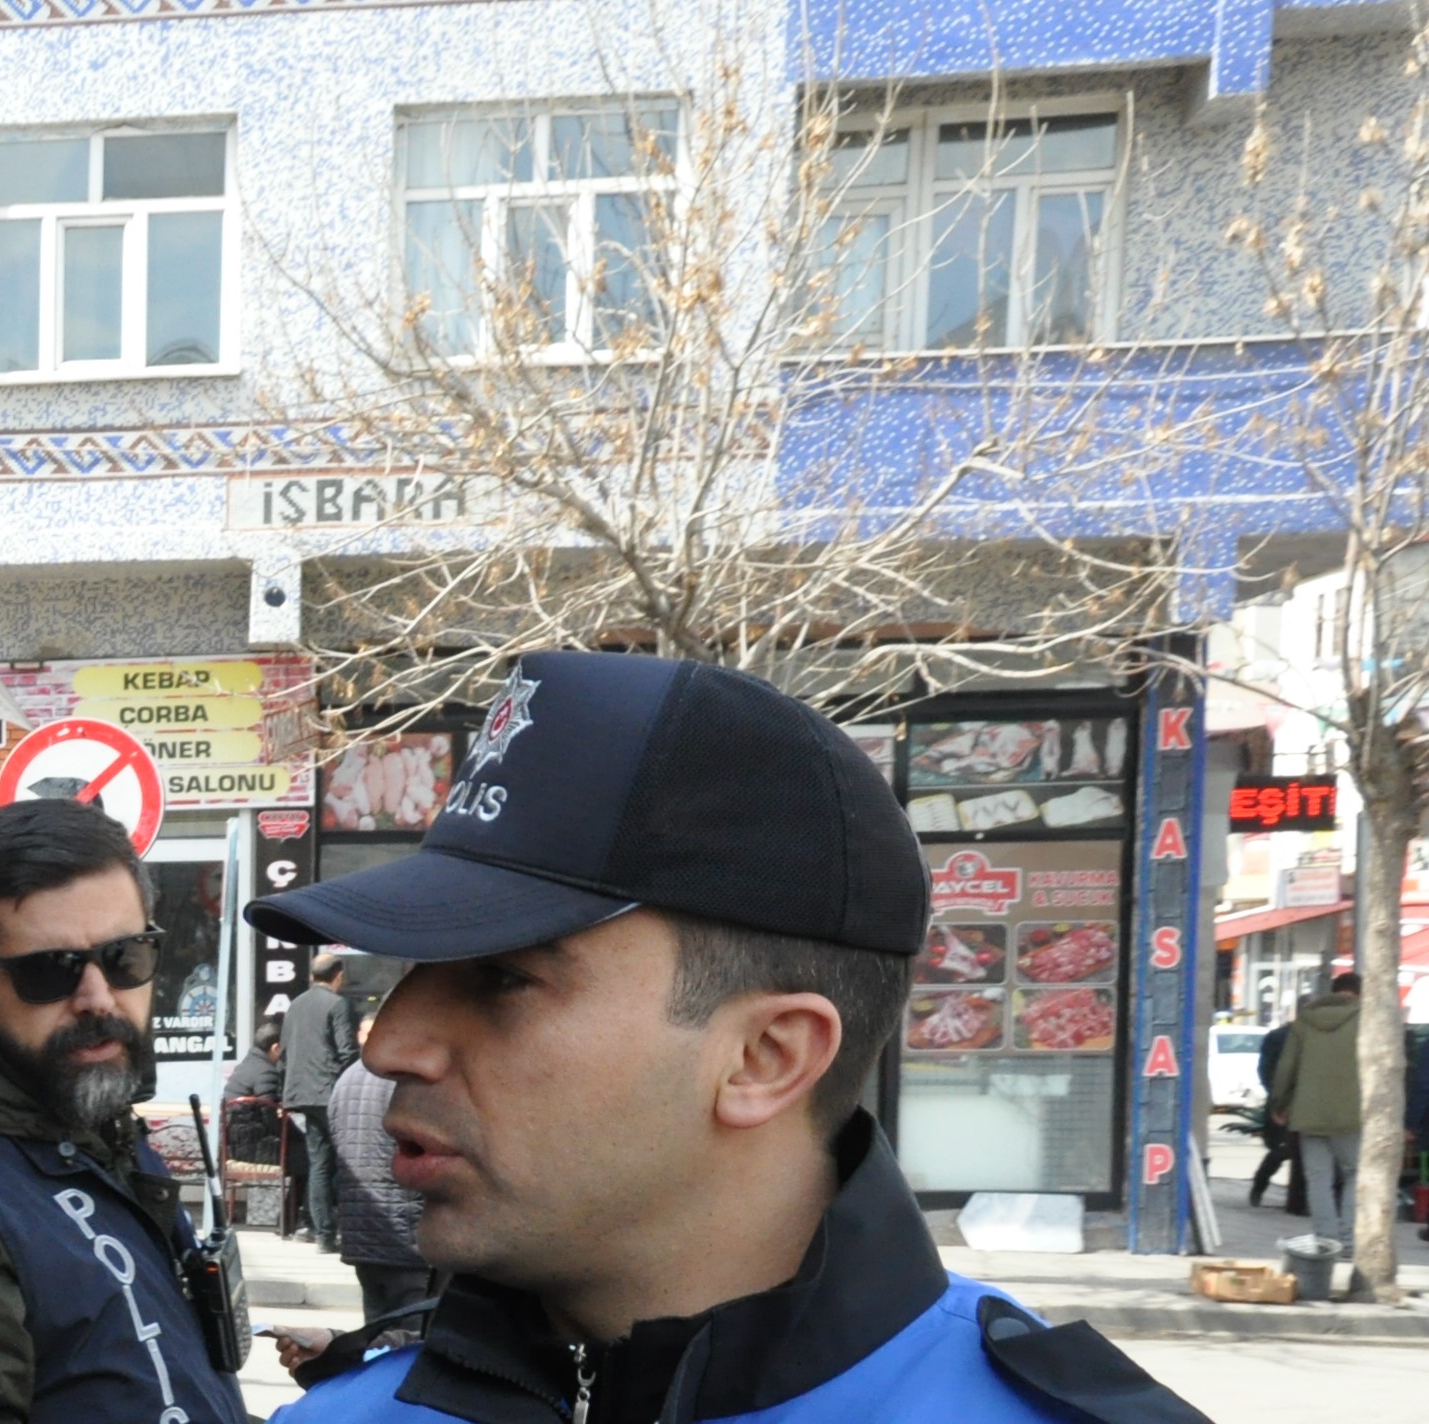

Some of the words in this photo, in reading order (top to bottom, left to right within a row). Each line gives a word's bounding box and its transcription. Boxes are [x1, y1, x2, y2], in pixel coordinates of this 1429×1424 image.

[123, 670, 211, 691] KEBAP
[119, 704, 209, 729] ÇORBA
[143, 738, 212, 760] ÖNER
[168, 773, 276, 794] SALONU
[445, 779, 508, 822] OLİS
[1142, 708, 1191, 1185] KASAP
[153, 1035, 233, 1055] ANGAL
